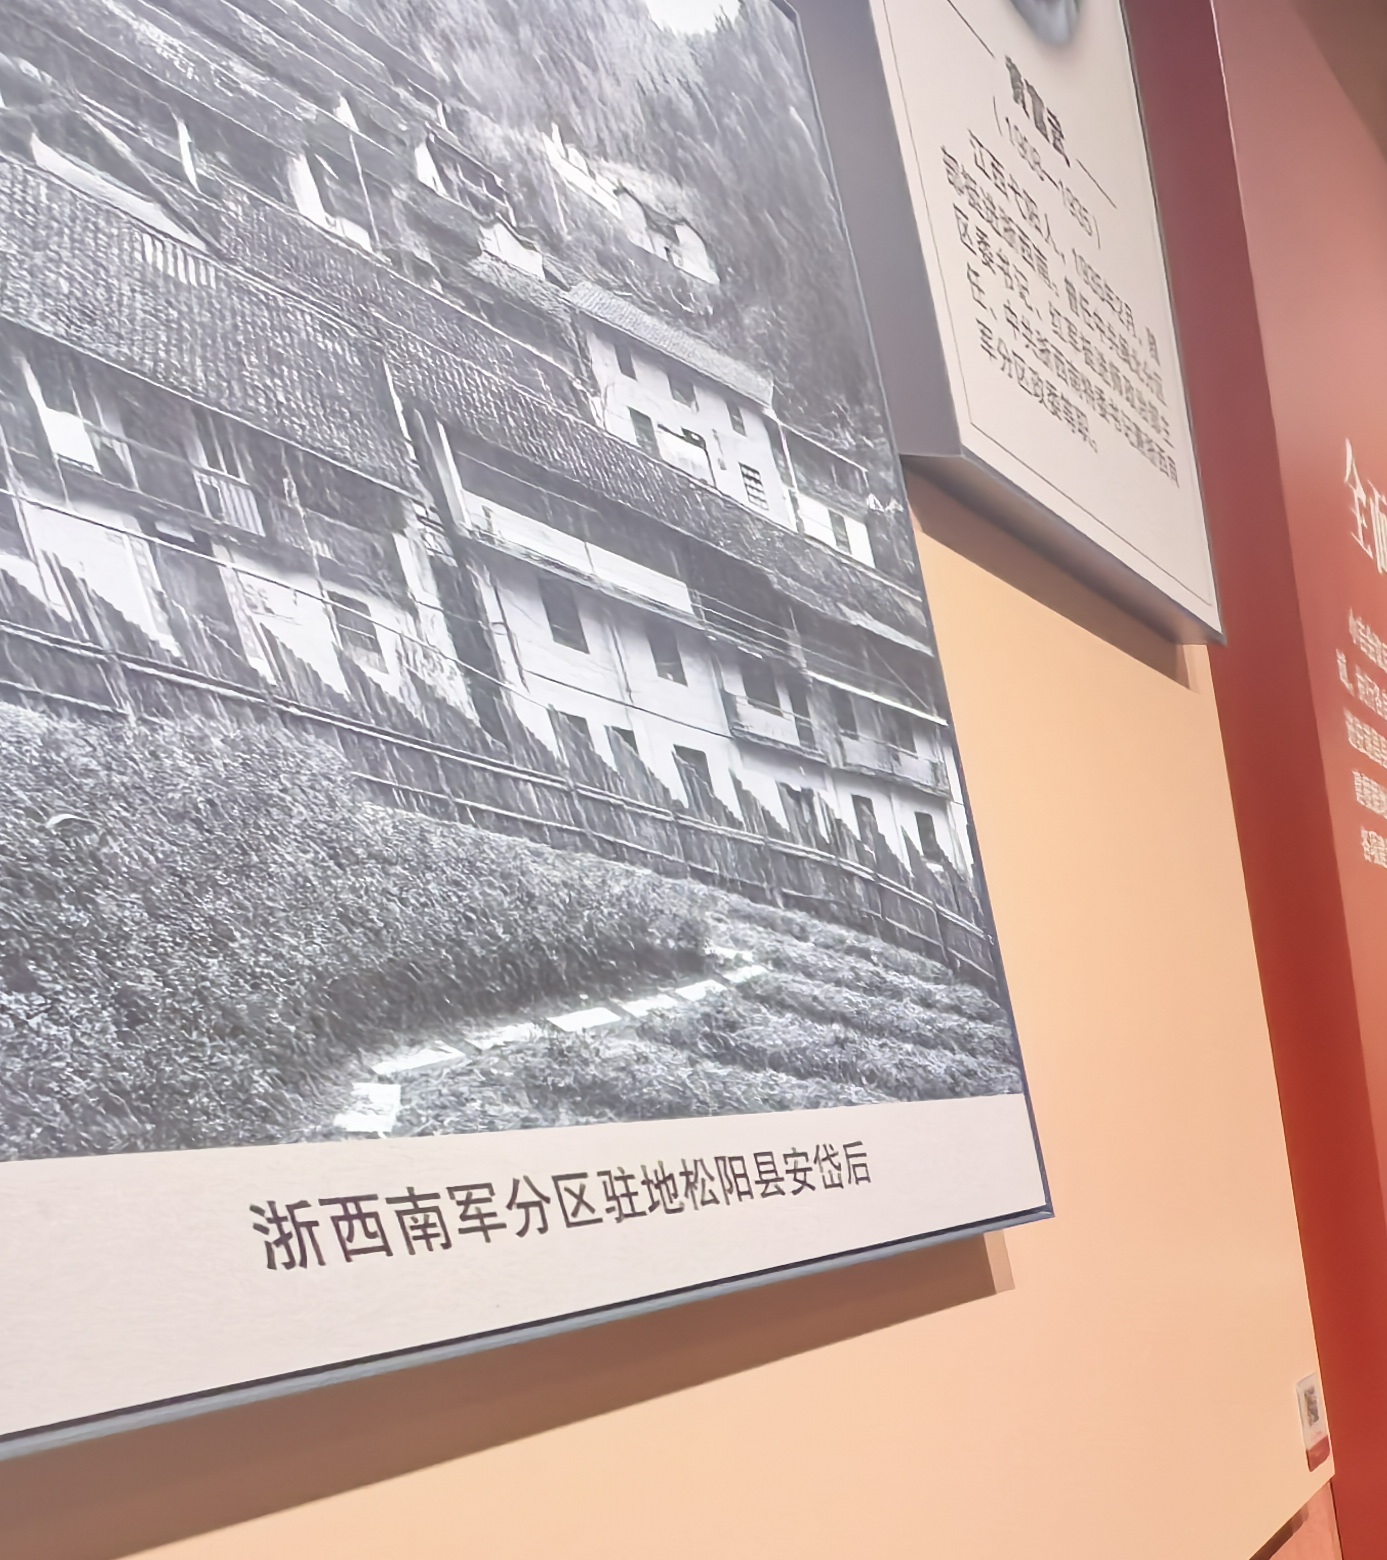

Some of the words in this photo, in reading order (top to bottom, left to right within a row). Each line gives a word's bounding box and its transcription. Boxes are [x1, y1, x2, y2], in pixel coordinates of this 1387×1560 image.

[249, 1141, 874, 1272] 浙西南军分区驻地松阳县安岱后
